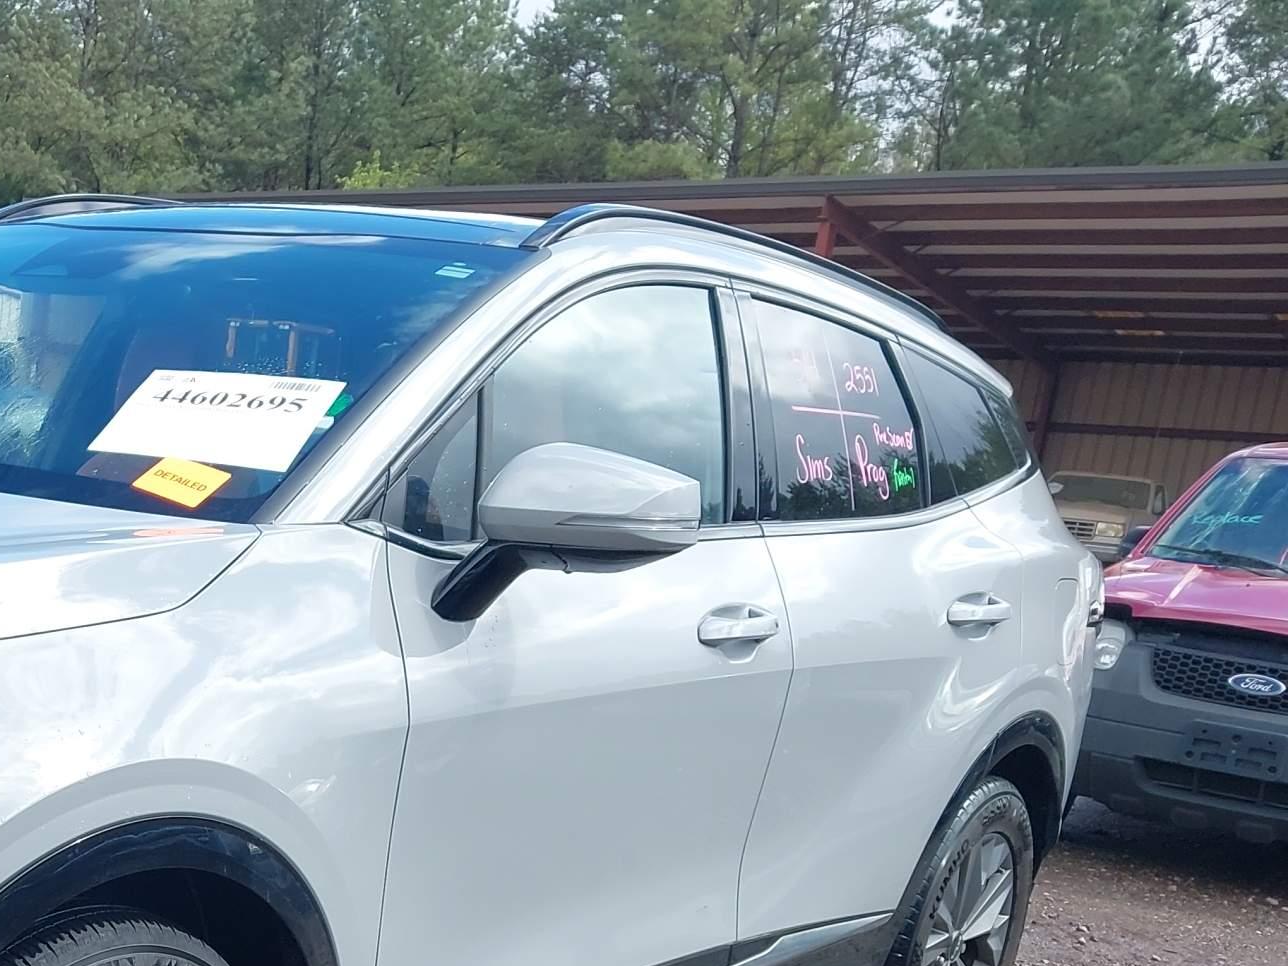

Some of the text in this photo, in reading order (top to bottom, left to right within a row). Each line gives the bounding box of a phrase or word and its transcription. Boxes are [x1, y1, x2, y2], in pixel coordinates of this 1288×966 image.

[152, 388, 309, 413] 44602695
[855, 434, 890, 500] Prog
[153, 469, 208, 493] DETAILED
[1239, 675, 1273, 693] Ford
[929, 838, 970, 920] KUMHO
